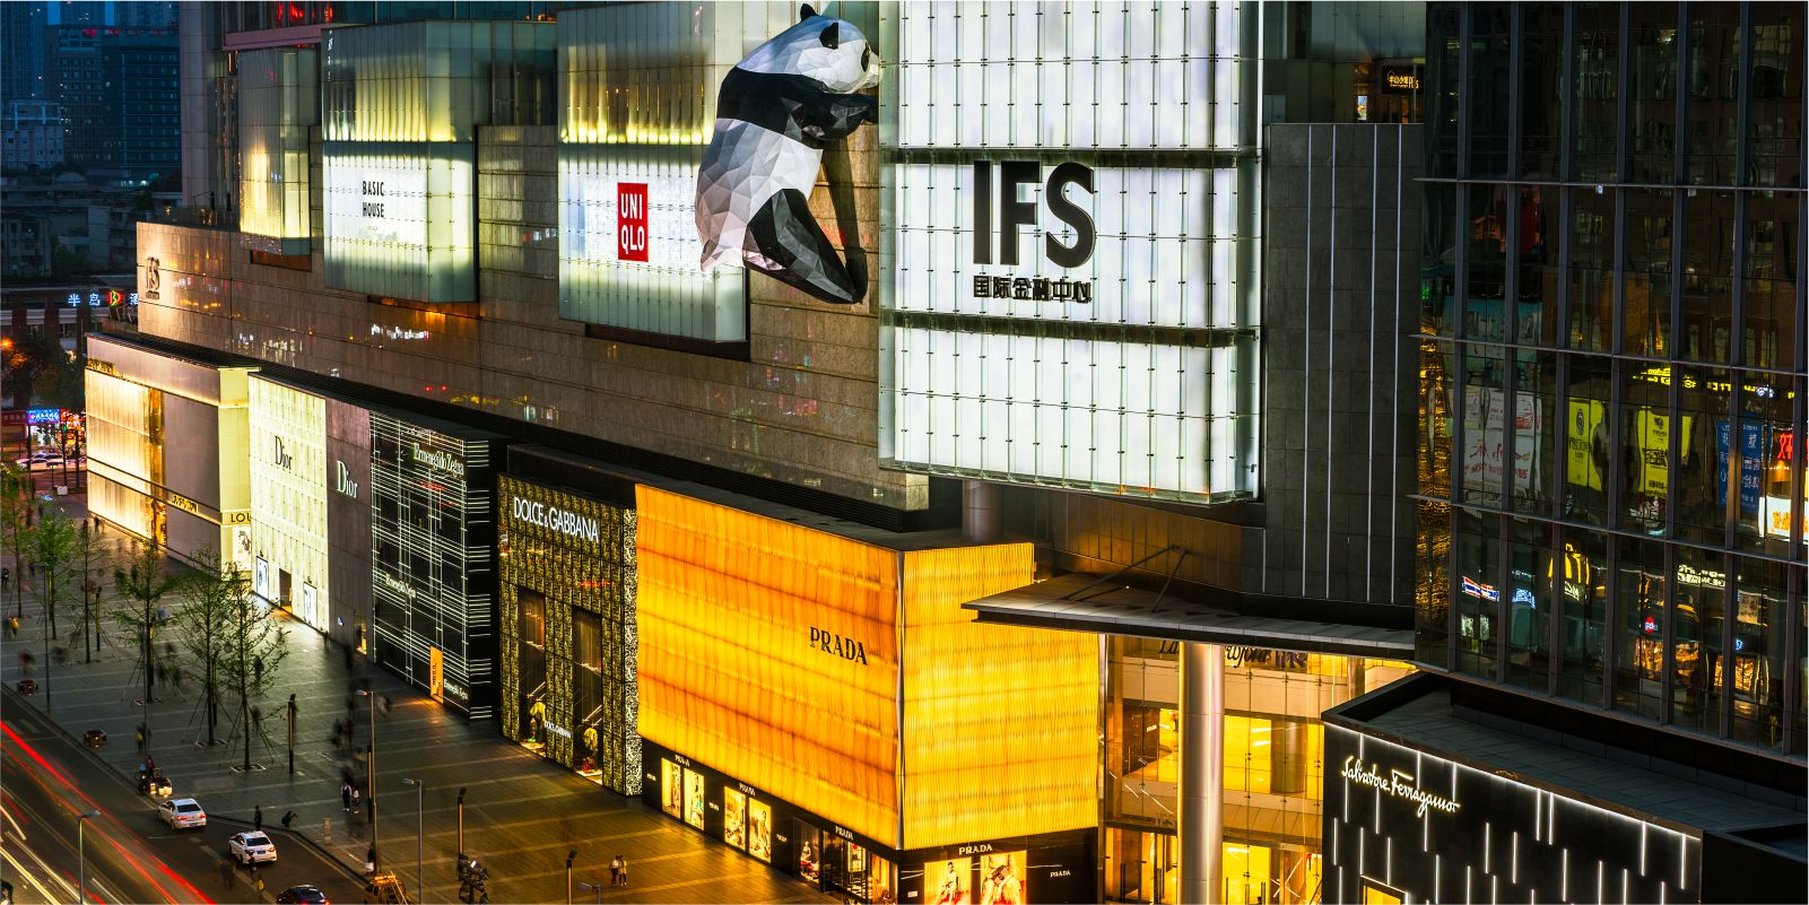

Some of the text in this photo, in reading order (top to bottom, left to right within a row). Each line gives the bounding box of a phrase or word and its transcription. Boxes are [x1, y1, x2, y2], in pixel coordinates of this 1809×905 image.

[362, 180, 385, 197] BASIC
[362, 202, 385, 218] HOUSE
[621, 193, 643, 220] UNI
[973, 161, 1097, 268] IFS
[621, 224, 645, 255] QLO
[973, 275, 1092, 303] 国际金融中心
[275, 435, 292, 470] Dior
[336, 460, 358, 498] Dior
[810, 626, 868, 666] PRADA
[1341, 756, 1461, 818] Salvatore Ferragamo
[958, 843, 993, 855] PRADA
[1050, 869, 1071, 878] PRADA
